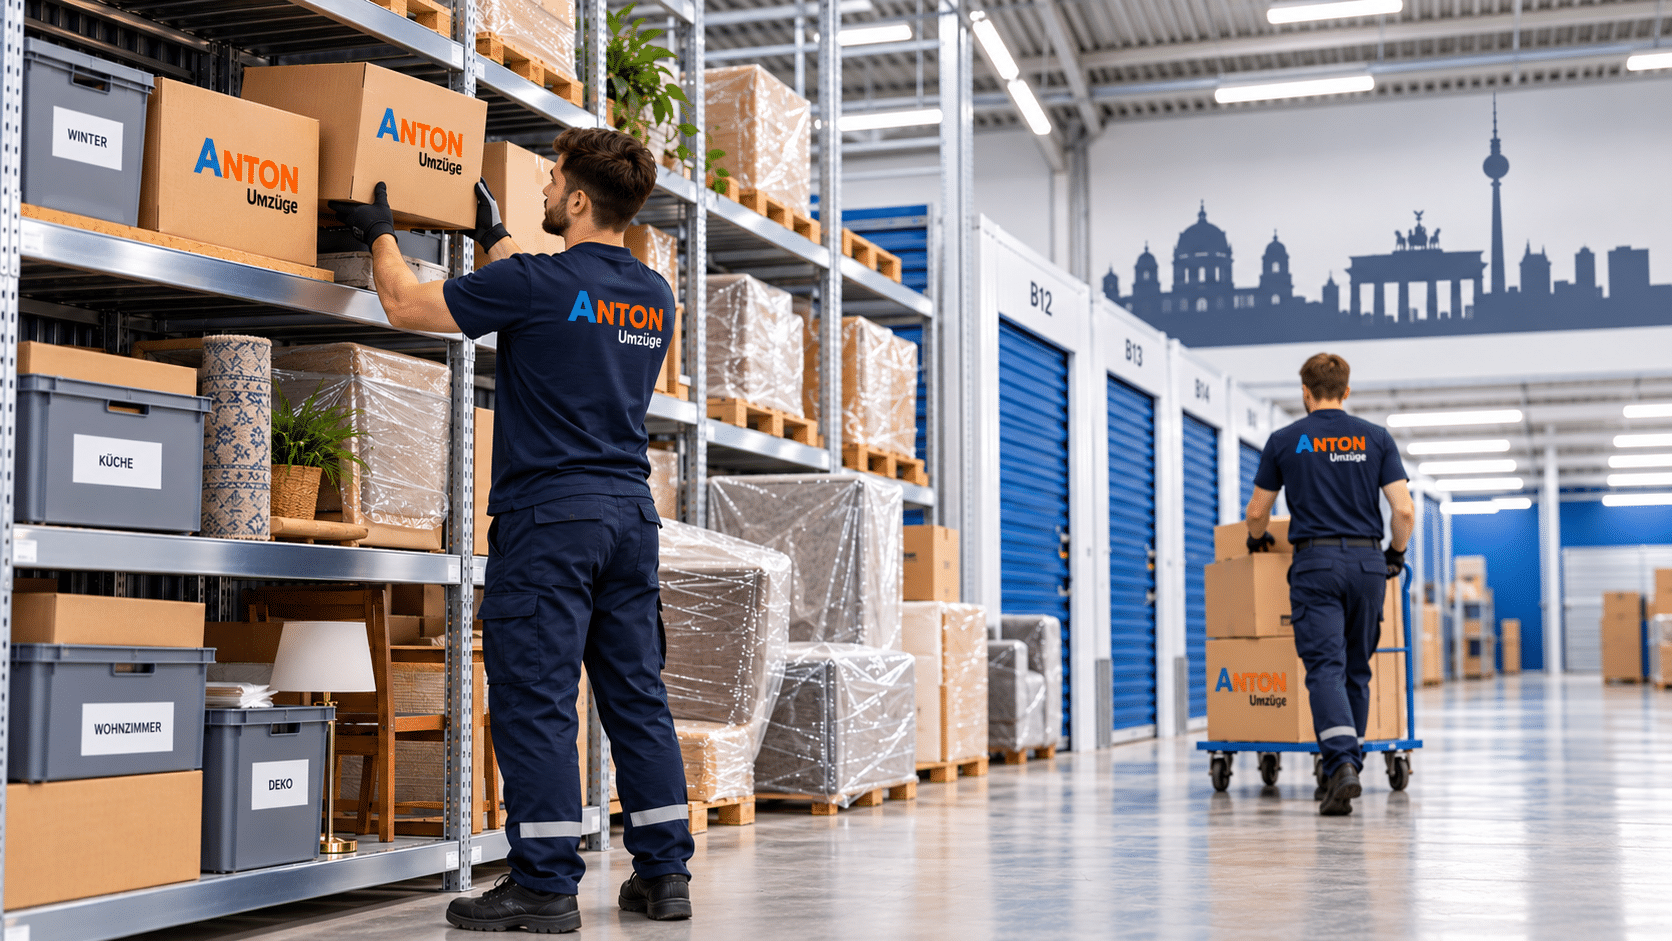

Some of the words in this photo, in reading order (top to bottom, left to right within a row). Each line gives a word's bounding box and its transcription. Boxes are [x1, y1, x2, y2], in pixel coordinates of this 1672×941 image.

[67, 128, 107, 149] WINTER
[376, 107, 463, 157] ANTON
[193, 137, 298, 194] ANTON
[418, 151, 462, 175] Umzüge
[247, 188, 298, 214] Umzüge
[567, 289, 664, 332] ANTON
[1030, 280, 1052, 317] B12
[618, 329, 662, 349] Umzüge
[1125, 338, 1143, 368] B13
[1195, 378, 1210, 403] B14
[1295, 434, 1366, 454] ANTON
[99, 452, 134, 470] KÜCHE
[1215, 667, 1287, 693] ANTON
[1249, 694, 1287, 708] Umzüge
[94, 721, 162, 735] WOHNZIMMER
[268, 778, 293, 791] DEKO
